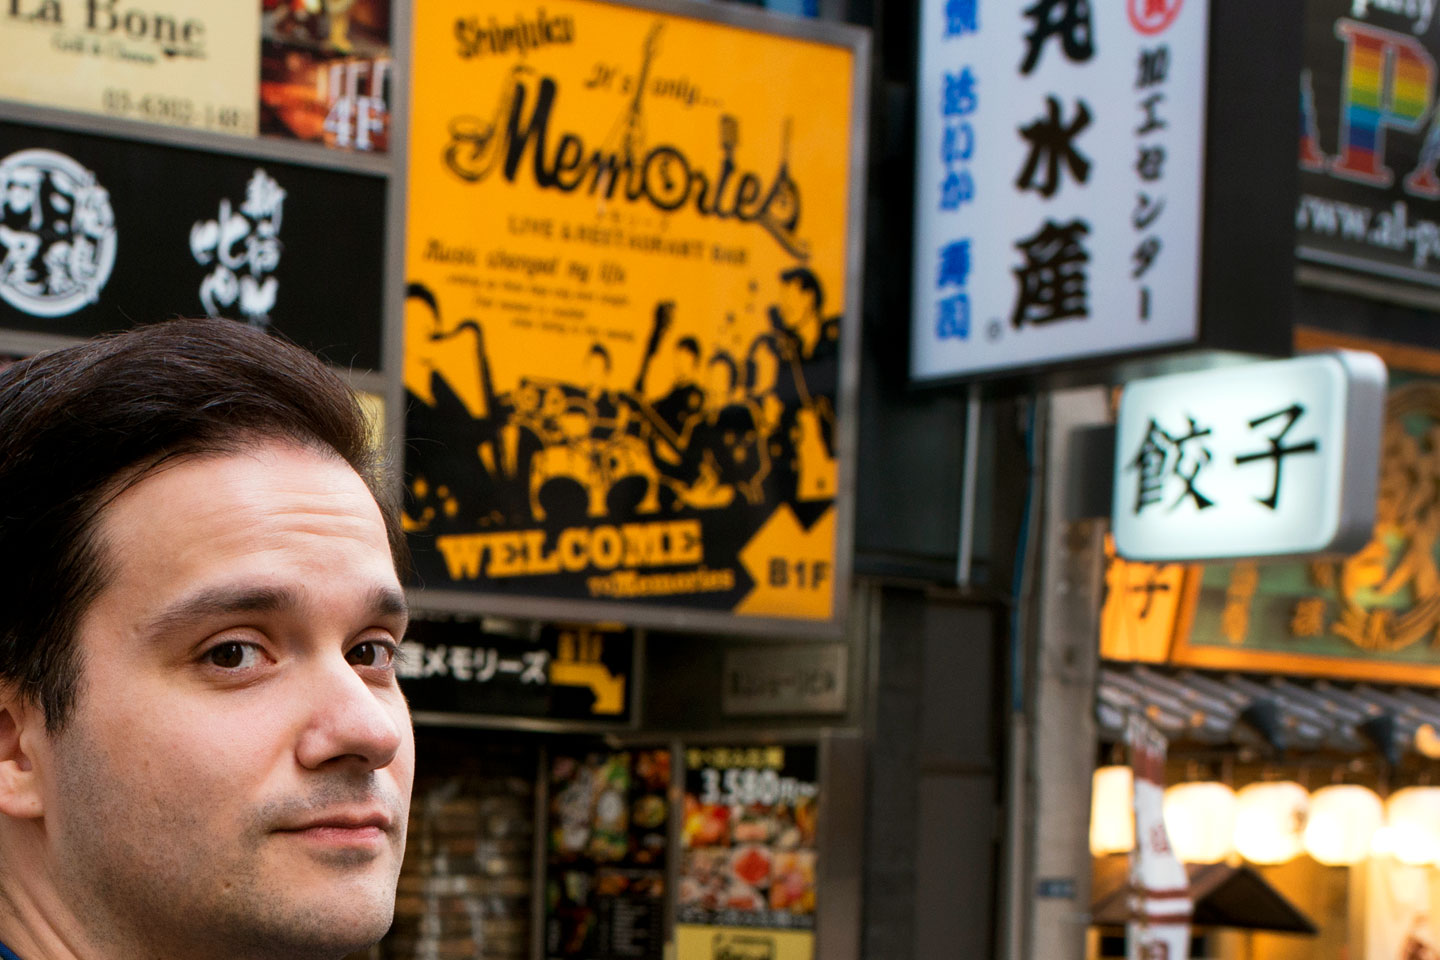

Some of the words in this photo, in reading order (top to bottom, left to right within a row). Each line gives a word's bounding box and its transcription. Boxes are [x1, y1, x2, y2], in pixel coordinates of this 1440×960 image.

[444, 76, 808, 262] Memories
[1130, 44, 1173, 322] 加工センター
[1127, 400, 1317, 515] 餃子
[436, 520, 704, 581] WELCOME
[768, 557, 830, 591] B1F
